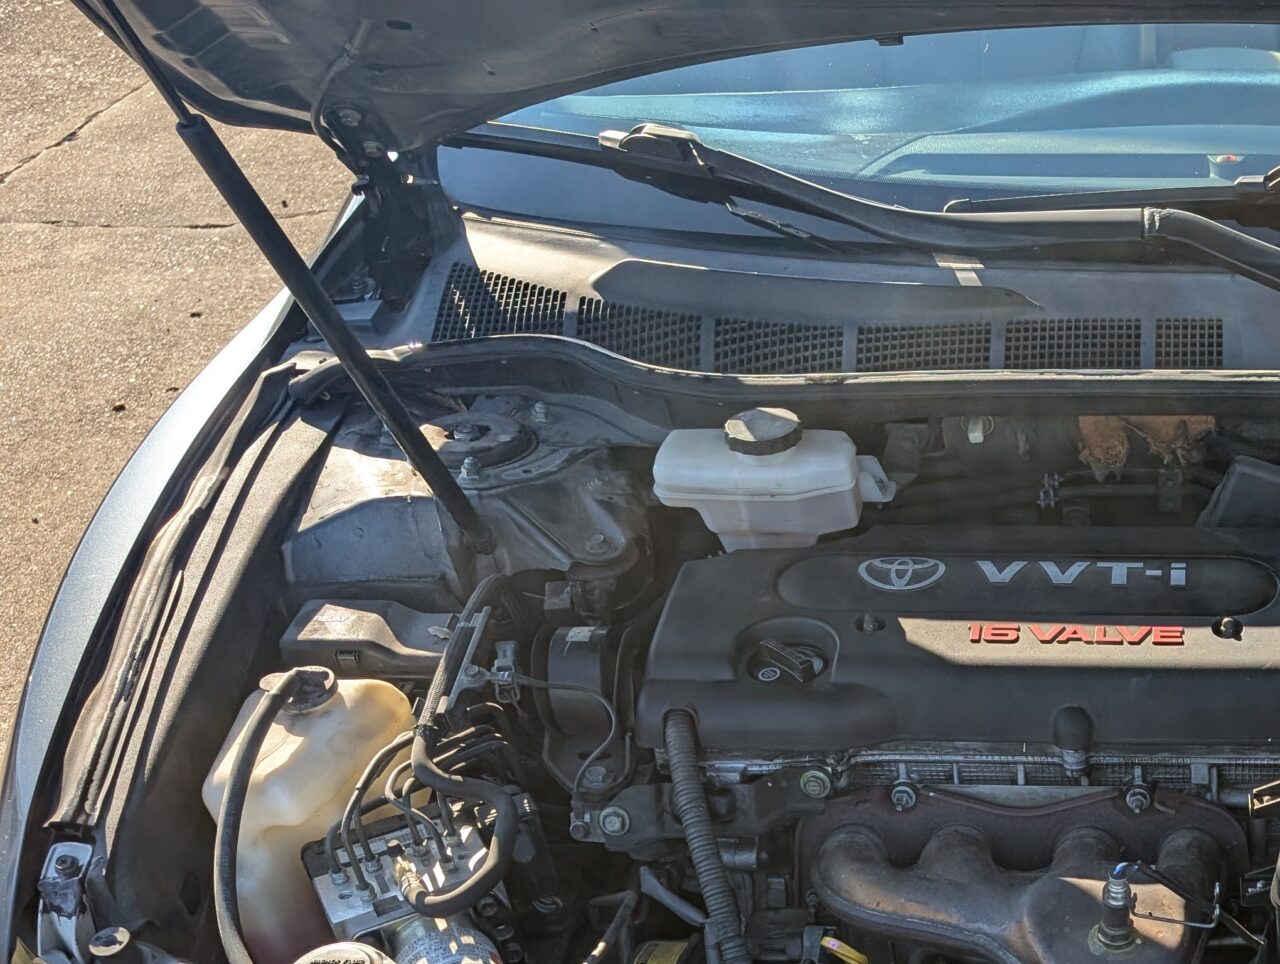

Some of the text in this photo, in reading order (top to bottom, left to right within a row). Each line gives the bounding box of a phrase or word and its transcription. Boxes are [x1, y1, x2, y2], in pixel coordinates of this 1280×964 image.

[976, 560, 1187, 586] VVT-i
[968, 623, 1185, 646] 16 VALVE
